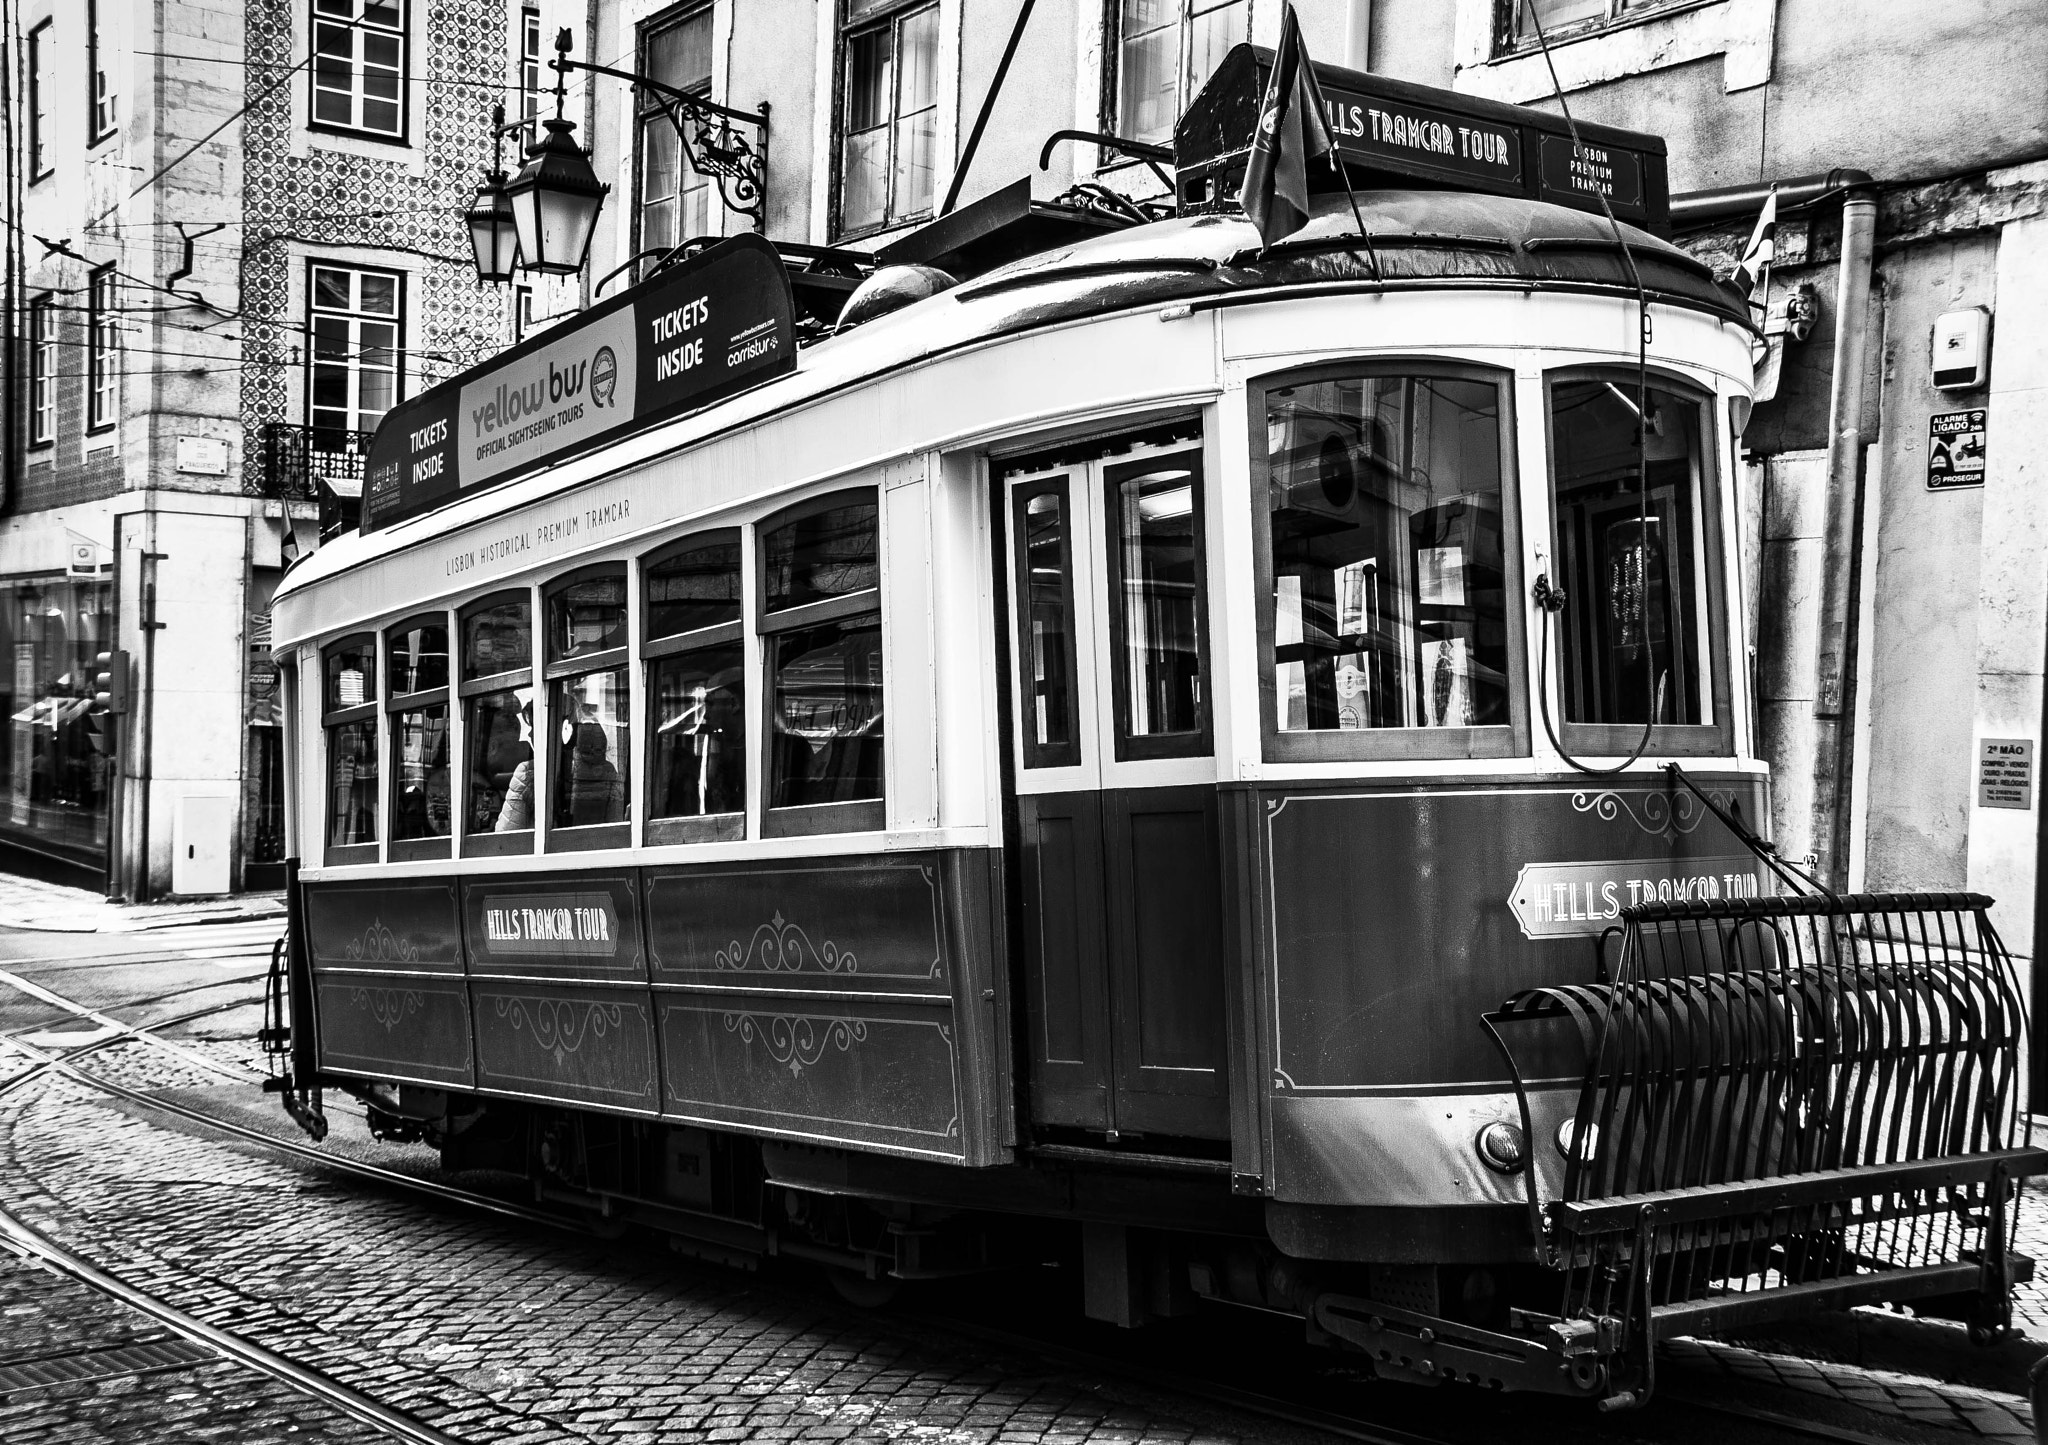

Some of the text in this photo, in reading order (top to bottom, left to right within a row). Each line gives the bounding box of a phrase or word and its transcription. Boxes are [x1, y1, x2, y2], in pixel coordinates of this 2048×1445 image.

[1368, 108, 1455, 156] TRAMCAR
[1458, 126, 1509, 166] TOUR
[1570, 160, 1612, 180] PREMIUM
[1573, 145, 1608, 163] LSBON
[652, 295, 709, 345] TICKETS
[657, 338, 704, 382] INSIDE
[728, 337, 770, 367] carristur
[472, 358, 587, 438] yellow bus
[476, 402, 584, 461] OFFICIAL SIGHTSEEING TOURS
[1933, 422, 1968, 432] LIGADO
[1934, 414, 1968, 424] ALARME
[1969, 424, 1983, 432] 24h
[409, 418, 448, 454] TICKETS
[412, 452, 444, 485] INSIDE
[1942, 473, 1982, 483] PROSEGUR
[446, 499, 630, 577] LISBON HISTORICAL PREMIUM TRAMCAR
[1999, 744, 2024, 755] MÃO
[1533, 881, 1620, 923] HILLS
[487, 908, 610, 941] HILLS TRAMCAR TOUR
